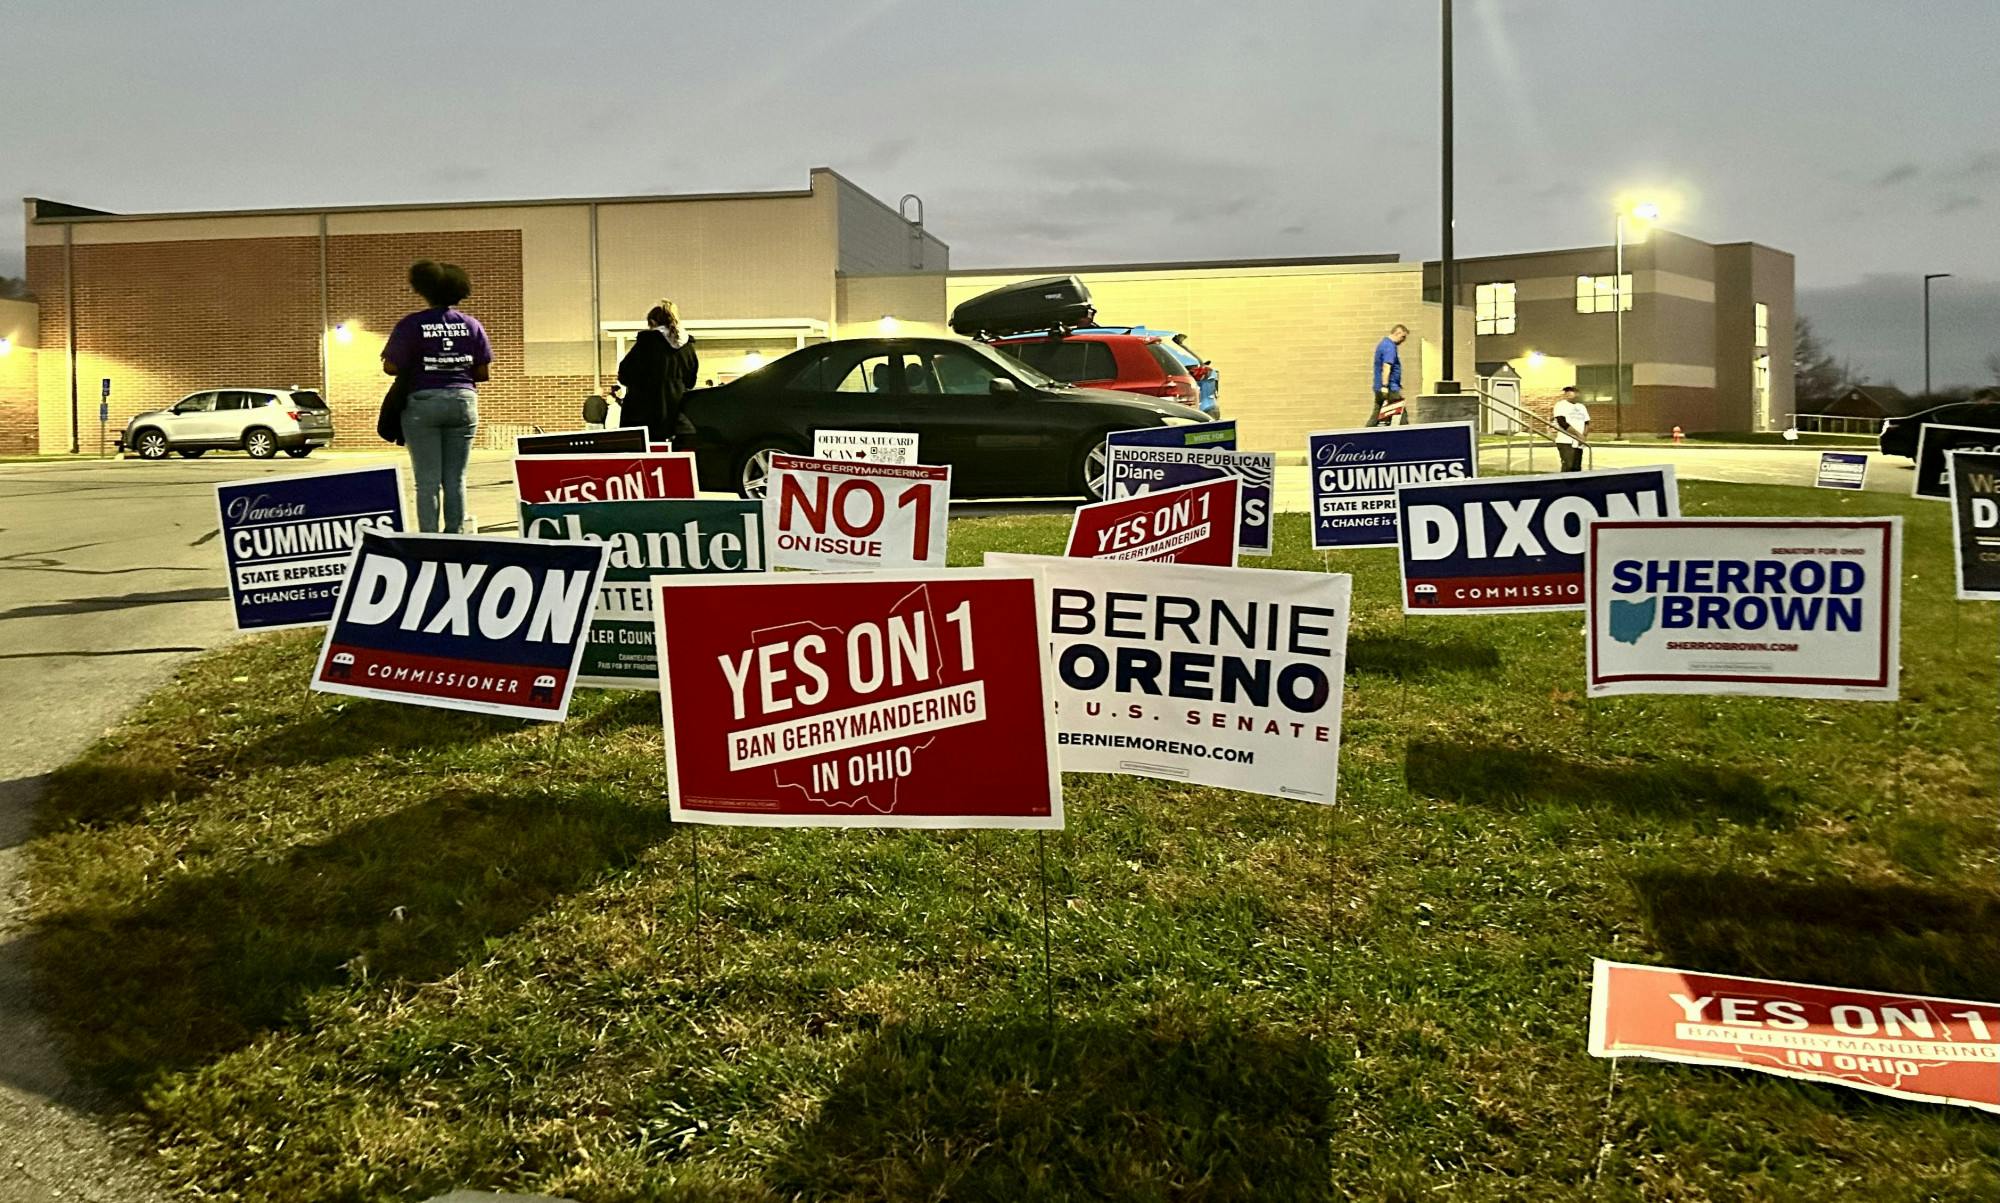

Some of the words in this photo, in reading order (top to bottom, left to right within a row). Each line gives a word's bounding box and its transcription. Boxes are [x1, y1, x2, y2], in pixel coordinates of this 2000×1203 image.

[423, 329, 469, 337] MATTERS!
[818, 435, 856, 445] OFFICIAL
[888, 438, 914, 446] CARD
[1316, 442, 1386, 466] Vanessa
[790, 460, 820, 471] STOP
[822, 463, 929, 479] GERRYMANDERING
[1114, 450, 1182, 463] ENDORSED
[1187, 453, 1270, 467] REPUBLICAN
[1115, 463, 1165, 480] Diane
[605, 471, 645, 500] ON
[651, 466, 666, 498] 1
[1318, 462, 1465, 493] CUMMINGS
[227, 494, 306, 525] Vanessa
[779, 473, 885, 538] NO
[898, 483, 932, 561] 1
[1097, 515, 1147, 552] YES
[1153, 499, 1190, 538] ON
[1197, 491, 1210, 521] 1
[1321, 519, 1330, 528] A
[1331, 517, 1379, 528] CHANGE
[1382, 516, 1391, 526] is
[1323, 501, 1357, 512] STATE
[777, 534, 811, 551] ON
[815, 537, 882, 557] ISSUE
[1119, 526, 1207, 561] GERRYMANDERING
[241, 570, 279, 585] STATE
[1455, 584, 1579, 599] COMMISSIO
[1612, 559, 1866, 595] SHERROD
[241, 594, 251, 606] A
[252, 588, 306, 604] CHANGE
[308, 588, 318, 598] is
[320, 590, 329, 598] a
[347, 553, 591, 644] DIXON
[594, 588, 653, 611] TTE
[1051, 588, 1335, 657] BERNIE
[1661, 595, 1862, 632] BROWN
[717, 634, 830, 720] YES
[846, 611, 930, 694] ON
[946, 600, 975, 672] 1
[1666, 641, 1799, 652] SHERRODBROWN.COM
[367, 664, 519, 694] COMMISSIONER
[1058, 643, 1330, 714] ORENO
[736, 731, 776, 761] BAN
[782, 690, 977, 751] GERRYMANDERING
[1086, 702, 1159, 720] U.S.
[1186, 710, 1330, 742] SENATE
[1058, 732, 1254, 764] BERNIEMORENO.COM
[812, 761, 840, 794] IN
[848, 746, 913, 787] OHIO
[1668, 993, 1809, 1031] YES
[1829, 1004, 1937, 1039] ON
[1950, 1010, 1992, 1040] 1
[1687, 1027, 1739, 1040] BAN
[1748, 1033, 1996, 1058] GERRYMANDERING
[1787, 1049, 1824, 1068] IN
[1834, 1056, 1919, 1076] OHIO
